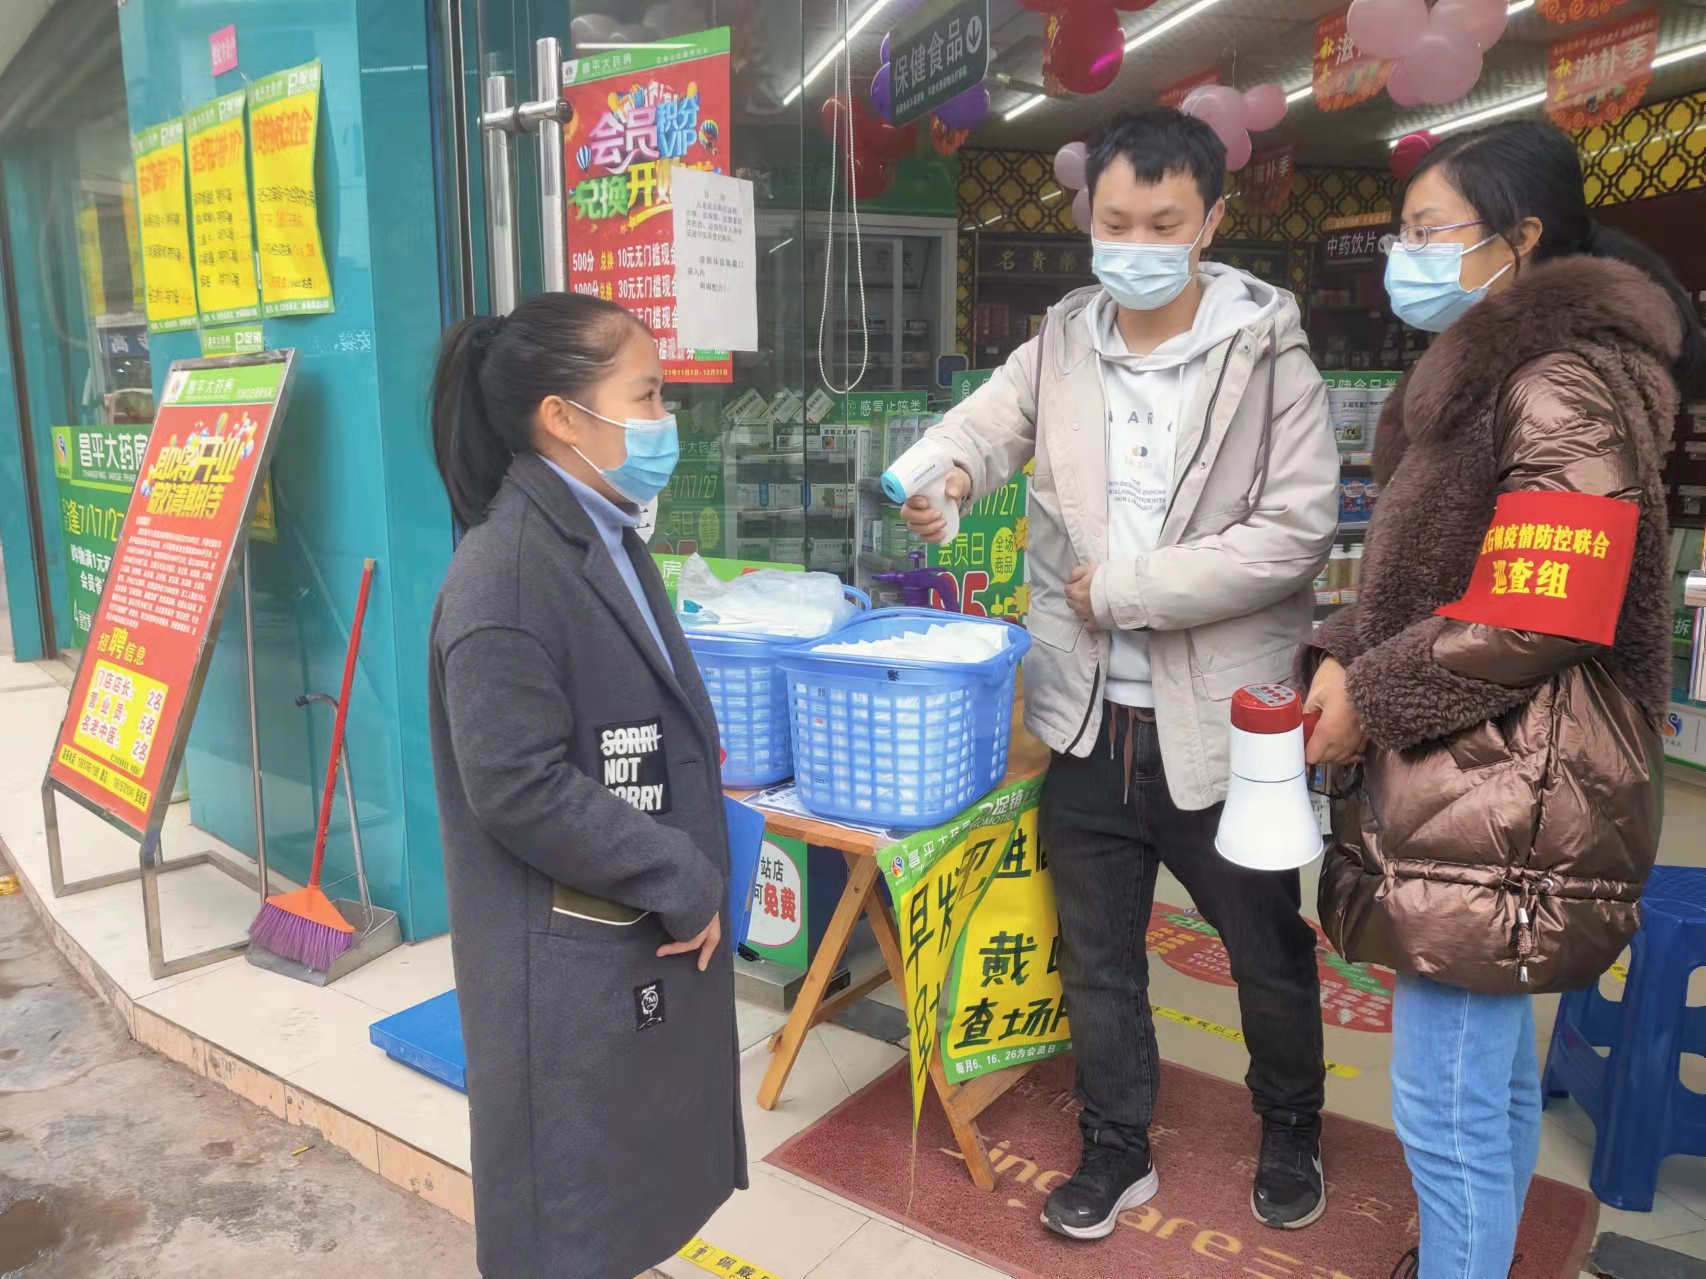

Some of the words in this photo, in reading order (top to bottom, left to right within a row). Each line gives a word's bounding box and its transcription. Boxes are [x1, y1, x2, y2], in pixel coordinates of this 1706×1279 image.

[894, 17, 963, 97] 保健食品
[589, 107, 660, 172] 会员
[658, 99, 700, 131] 积分
[660, 129, 698, 158] VIP
[573, 249, 595, 273] 500分
[599, 251, 615, 271] 兑换
[859, 398, 921, 417] 感冒止咳类
[78, 433, 147, 470] 昌平大药房
[153, 436, 245, 483] 即将开业
[146, 483, 226, 519] 敬请期待
[937, 532, 985, 567] 会员日
[1481, 523, 1611, 560] 石镇疫情防控联合
[994, 556, 1014, 575] 商品
[1491, 557, 1570, 599] 巡查组
[97, 627, 146, 667] 招聘信息
[146, 688, 165, 712] 2名
[140, 714, 156, 738] 5名
[132, 739, 149, 762] 2名
[604, 757, 642, 786] NOT
[608, 784, 664, 811] ORRY
[760, 857, 784, 883] 站店
